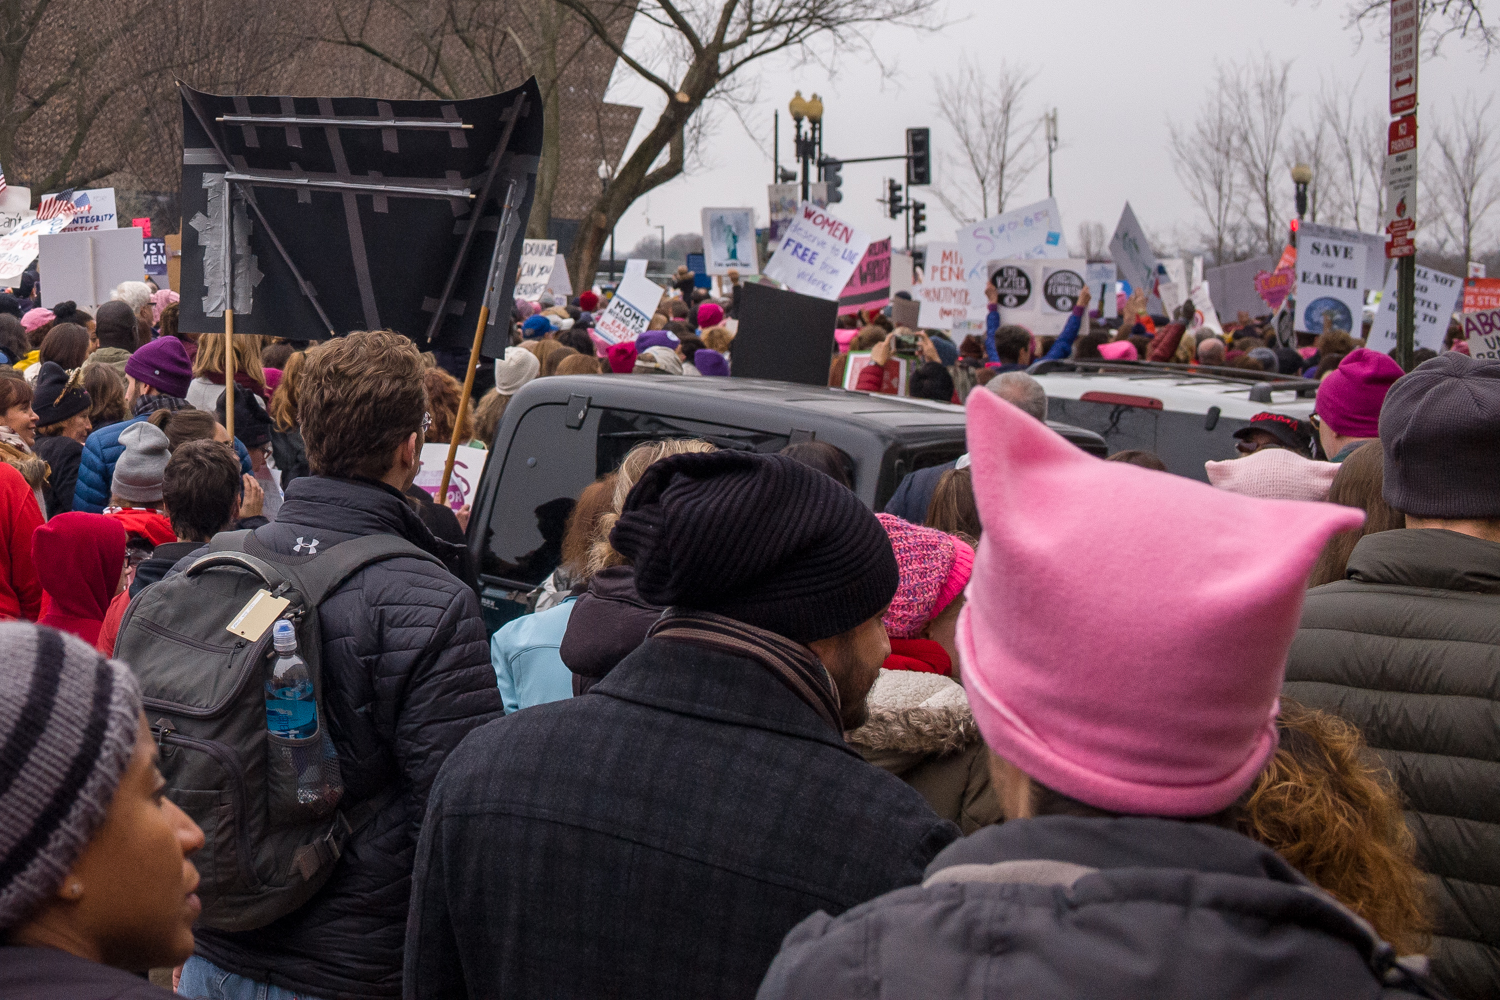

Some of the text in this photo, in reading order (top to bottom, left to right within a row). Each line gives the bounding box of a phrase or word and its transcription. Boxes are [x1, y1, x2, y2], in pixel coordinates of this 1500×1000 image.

[70, 213, 114, 225] NTEGRITY
[803, 206, 854, 244] WOMEN
[143, 255, 167, 265] MEN
[782, 238, 818, 265] FREE
[1311, 241, 1354, 260] SAVE
[1301, 271, 1358, 289] EARTH
[1432, 273, 1456, 288] NOT
[614, 301, 646, 328] MOMS
[611, 319, 635, 338] EARLY
[1250, 412, 1298, 431] OBAMA
